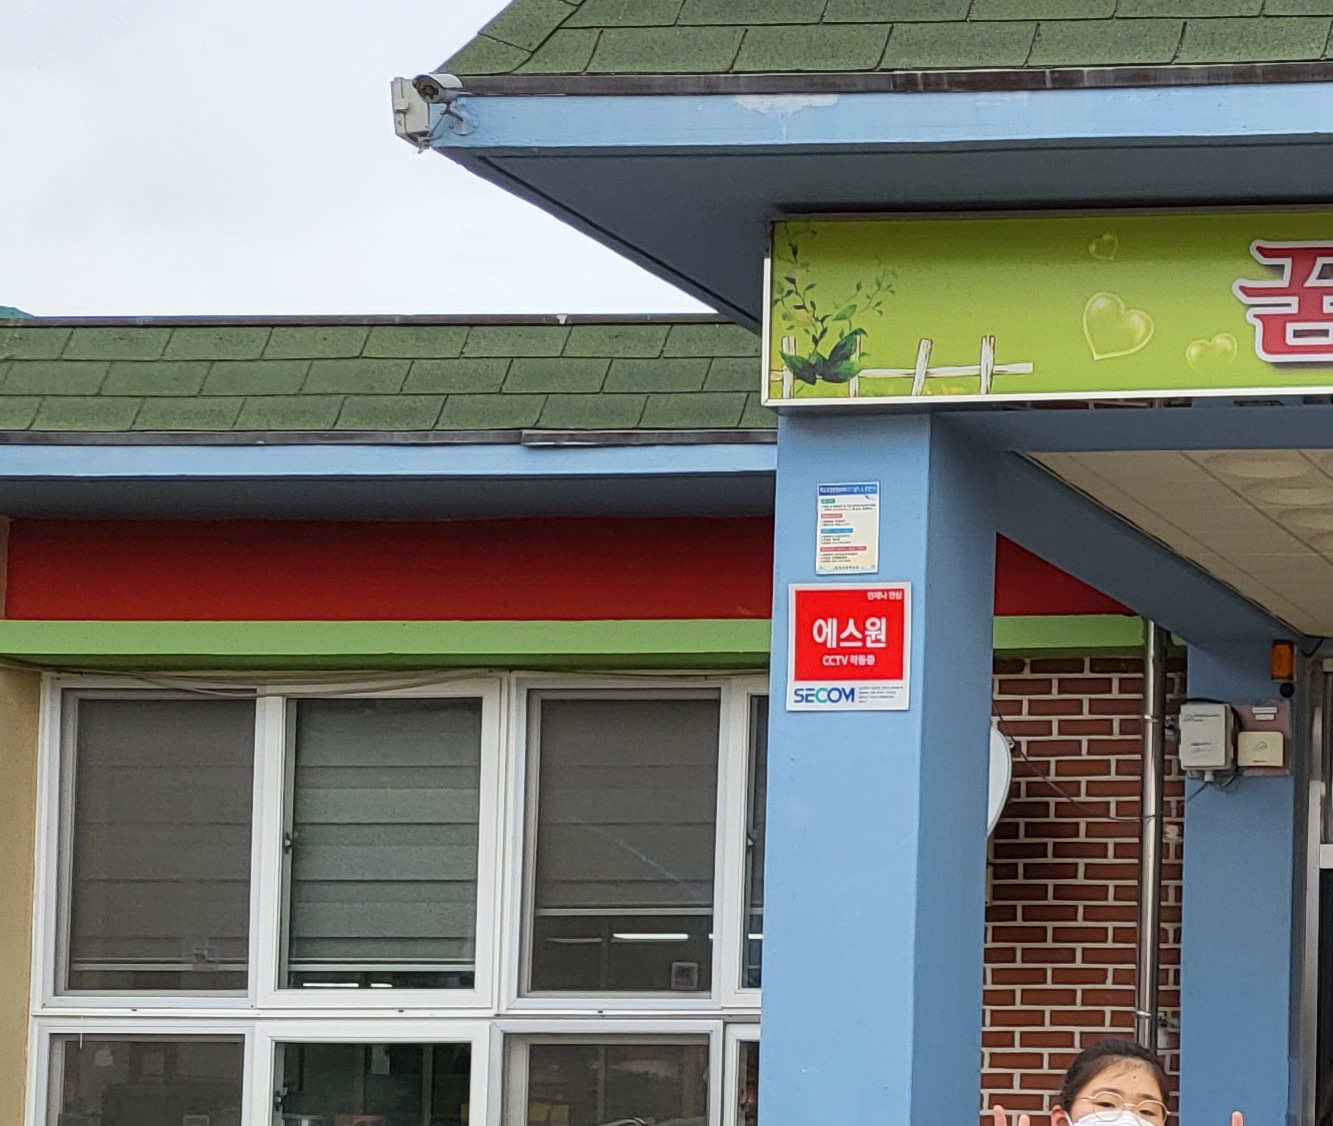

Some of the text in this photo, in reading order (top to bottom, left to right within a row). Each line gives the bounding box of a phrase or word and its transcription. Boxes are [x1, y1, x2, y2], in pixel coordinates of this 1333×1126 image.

[812, 617, 887, 648] 에스원
[822, 654, 876, 666] CCTV 작동중
[794, 687, 855, 703] SECOM
